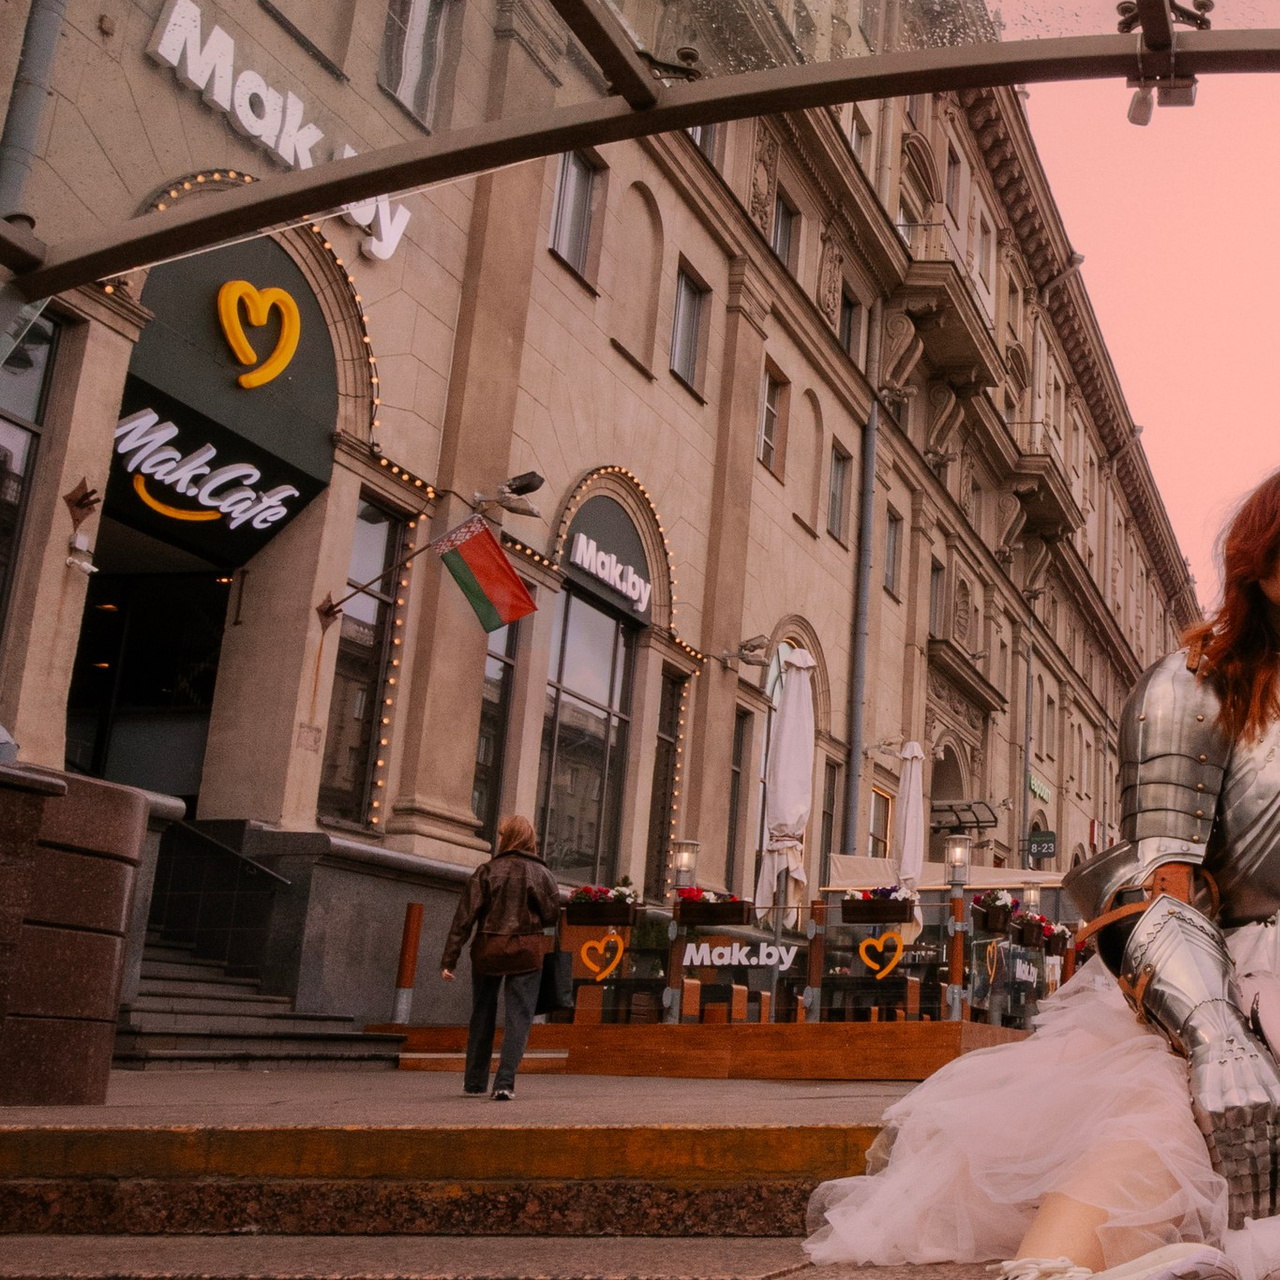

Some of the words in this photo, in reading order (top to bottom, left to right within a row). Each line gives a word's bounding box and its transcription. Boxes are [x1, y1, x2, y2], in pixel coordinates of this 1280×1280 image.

[115, 408, 300, 529] Mak.Cafe
[570, 533, 652, 612] Mak.by
[1031, 843, 1055, 853] 8-23
[682, 942, 799, 971] Mak.by
